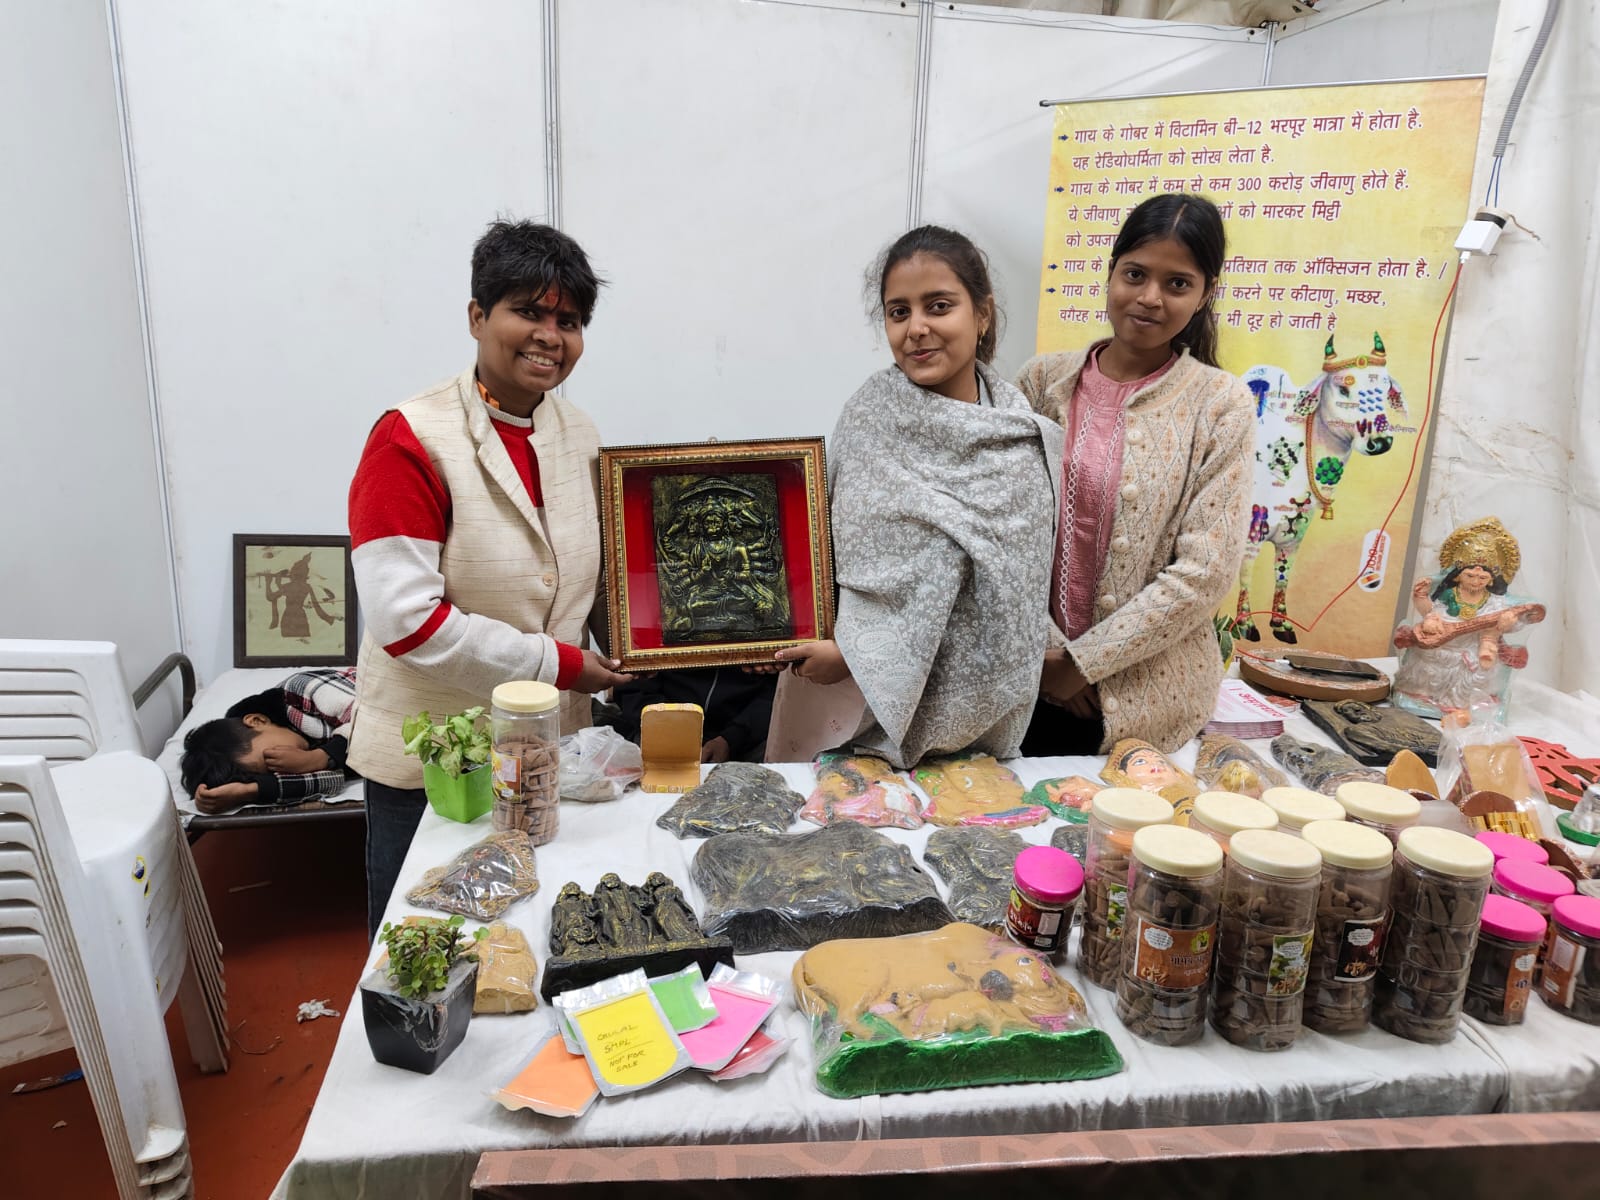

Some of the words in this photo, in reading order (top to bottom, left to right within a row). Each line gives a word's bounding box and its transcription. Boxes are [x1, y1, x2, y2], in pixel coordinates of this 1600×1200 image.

[1075, 130, 1097, 142] गाय
[1103, 125, 1114, 141] के
[1120, 124, 1149, 140] गोबर
[1155, 122, 1164, 138] में
[1169, 120, 1218, 137] विटामिन
[1271, 119, 1307, 138] भरपूर
[1313, 117, 1345, 131] मात्रा
[1352, 111, 1364, 130] में
[1369, 110, 1402, 131] होता
[1408, 108, 1421, 129] है.
[1073, 157, 1090, 170] यह
[1168, 148, 1186, 165] को
[1191, 147, 1223, 164] सोख
[1229, 145, 1256, 163] लेता
[1261, 144, 1273, 163] है.
[1071, 183, 1093, 195] गाय
[1098, 178, 1110, 194] के
[1116, 177, 1144, 194] गोबर
[1149, 176, 1159, 192] में
[1163, 180, 1186, 193] कम
[1191, 175, 1203, 191] से
[1209, 178, 1232, 191] कम
[1237, 178, 1261, 191] 300
[1269, 172, 1304, 193] करोड़
[1310, 172, 1356, 195] जीवाणु
[1362, 170, 1389, 190] होते
[1395, 169, 1408, 190] हैं.
[1069, 205, 1079, 221] ये
[1083, 205, 1120, 225] जीवाणु
[1239, 201, 1257, 218] को
[1263, 205, 1306, 218] मारकर
[1312, 200, 1341, 221] मिट्टी
[1066, 231, 1081, 247] को
[1064, 260, 1086, 272] गाय
[1091, 256, 1103, 272] के
[1224, 256, 1268, 273] प्रतिशत
[1274, 261, 1297, 273] तक
[1304, 257, 1372, 275] ऑक्सिजन
[1378, 258, 1410, 277] होता
[1416, 258, 1429, 278] है.
[1062, 285, 1084, 296] गाय
[1089, 281, 1100, 296] के
[1233, 283, 1262, 300] करने
[1268, 288, 1285, 300] पर
[1291, 284, 1338, 308] कीटाणु,
[1347, 290, 1385, 306] मच्छर,
[1060, 306, 1090, 323] वगैरह
[1228, 310, 1242, 325] भी
[1248, 314, 1264, 332] दूर
[1270, 311, 1283, 328] हो
[1289, 312, 1322, 329] जाती
[1328, 312, 1337, 331] है
